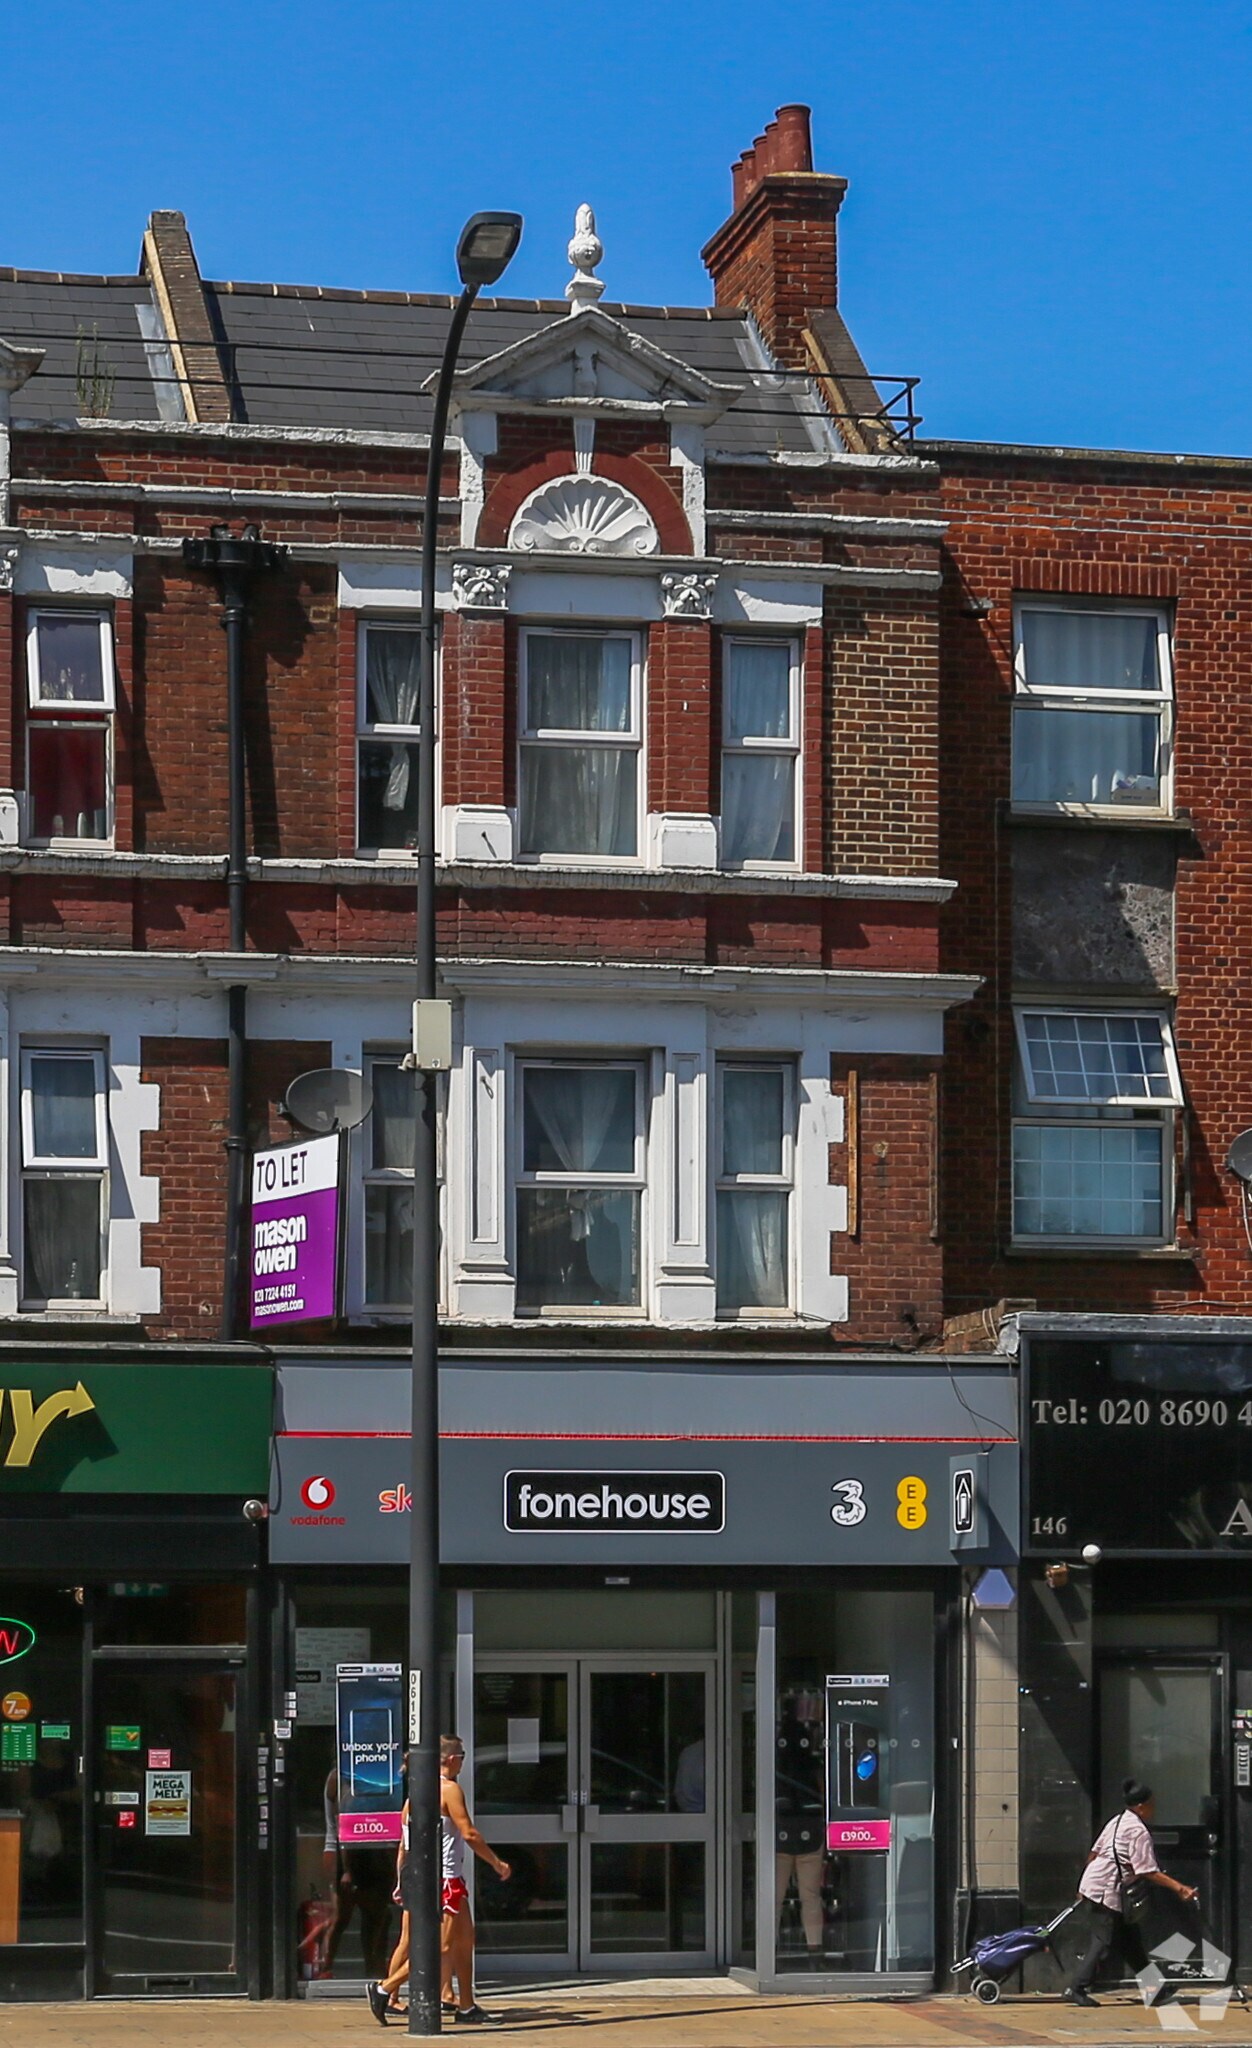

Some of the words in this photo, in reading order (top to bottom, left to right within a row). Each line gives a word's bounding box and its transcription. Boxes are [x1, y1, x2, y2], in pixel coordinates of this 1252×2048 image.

[257, 1158, 277, 1192] TO
[282, 1150, 308, 1188] LET
[254, 1215, 307, 1249] mason
[254, 1244, 296, 1276] owen
[264, 1286, 280, 1301] 7224
[280, 1283, 296, 1298] 4151
[1031, 1399, 1088, 1425] Tel:
[1099, 1398, 1150, 1425] 020
[1160, 1399, 1228, 1426] 8690
[378, 1483, 412, 1513] sk
[518, 1484, 712, 1519] fonehouse
[830, 1477, 868, 1527] 3
[290, 1515, 346, 1526] vodafone
[1032, 1517, 1068, 1535] 146
[342, 1742, 374, 1752] Unbox
[376, 1742, 399, 1755] your
[355, 1753, 388, 1765] phone
[152, 1780, 185, 1789] MEGA
[155, 1789, 183, 1799] MELT
